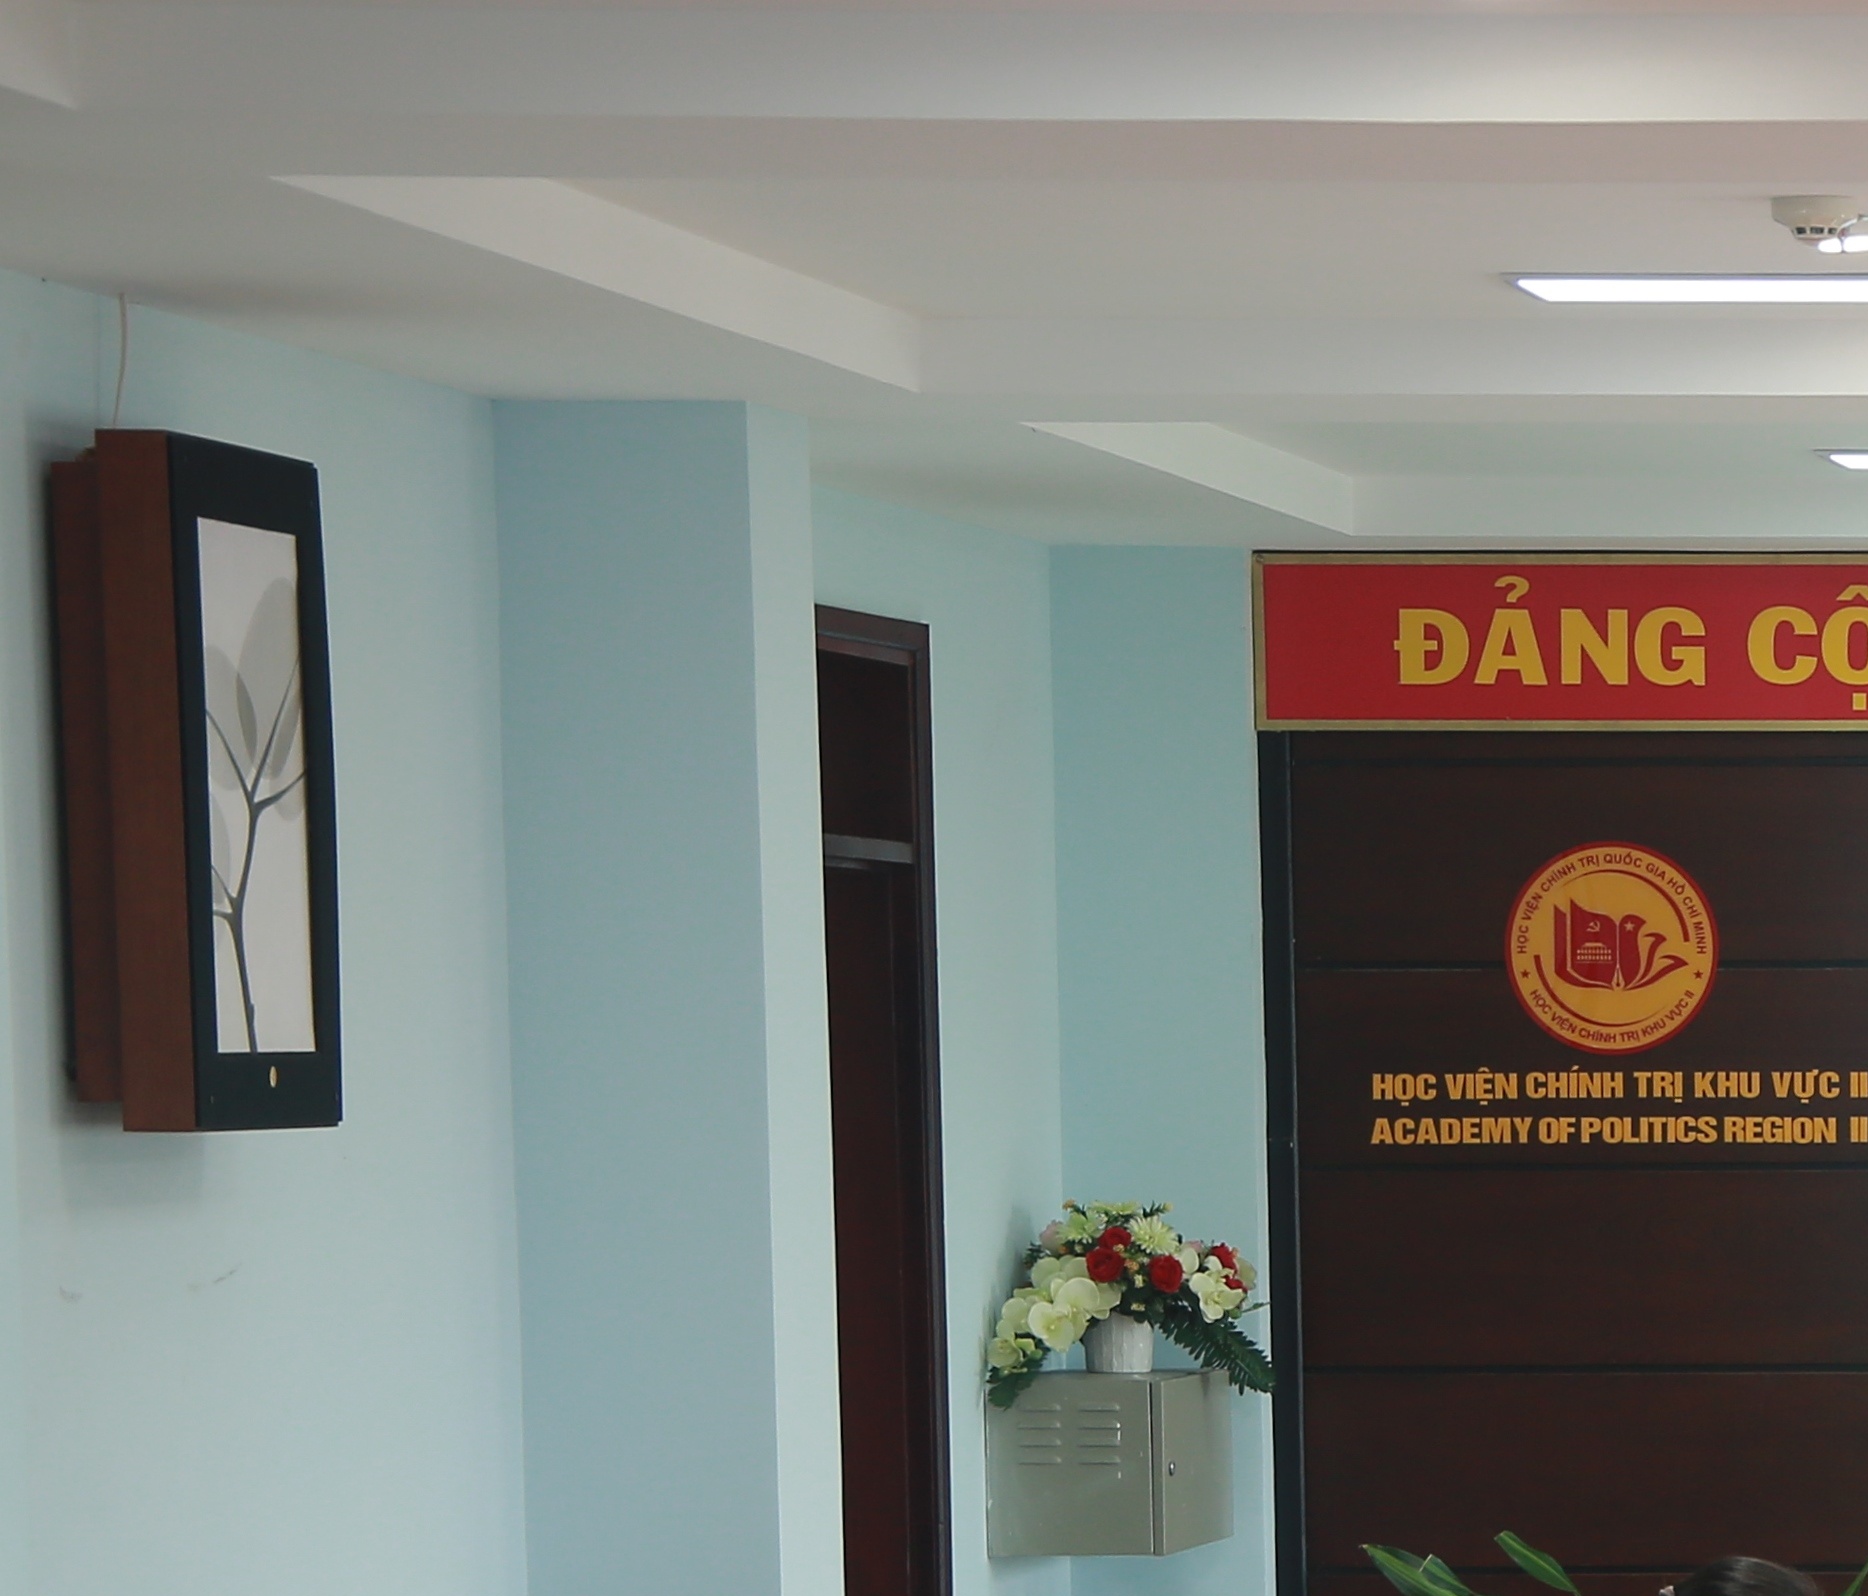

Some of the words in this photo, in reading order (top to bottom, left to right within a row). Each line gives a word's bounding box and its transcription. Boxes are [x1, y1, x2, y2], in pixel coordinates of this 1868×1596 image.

[1395, 576, 1706, 686] ĐẢNG
[1578, 854, 1600, 868] TRỊ
[1646, 862, 1667, 880] GIA
[1541, 862, 1576, 892] CHÍNH
[1521, 892, 1543, 921] VIỆN
[1683, 896, 1702, 918] CHÍ
[1517, 925, 1530, 954] HỌC
[1693, 921, 1707, 954] MINH
[1530, 988, 1552, 1015] HỌC
[1551, 1011, 1577, 1034] VIỆN
[1578, 1027, 1617, 1043] CHÍNH
[1619, 1031, 1640, 1043] TRỊ
[1642, 1017, 1667, 1038] KHU
[1664, 997, 1689, 1021] VỰC
[1684, 989, 1695, 1000] II
[1372, 1073, 1437, 1107] HỌC
[1444, 1067, 1518, 1105] VIỆN
[1525, 1065, 1624, 1099] CHÍNH
[1633, 1071, 1683, 1103] TRỊ
[1694, 1071, 1761, 1099] KHU
[1771, 1068, 1841, 1104] VỰC
[1849, 1071, 1868, 1098] II
[1371, 1117, 1533, 1145] ACADEMY
[1538, 1117, 1576, 1144] OF
[1580, 1116, 1718, 1144] POLITICS
[1723, 1116, 1837, 1144] REGION
[1849, 1116, 1868, 1143] II
